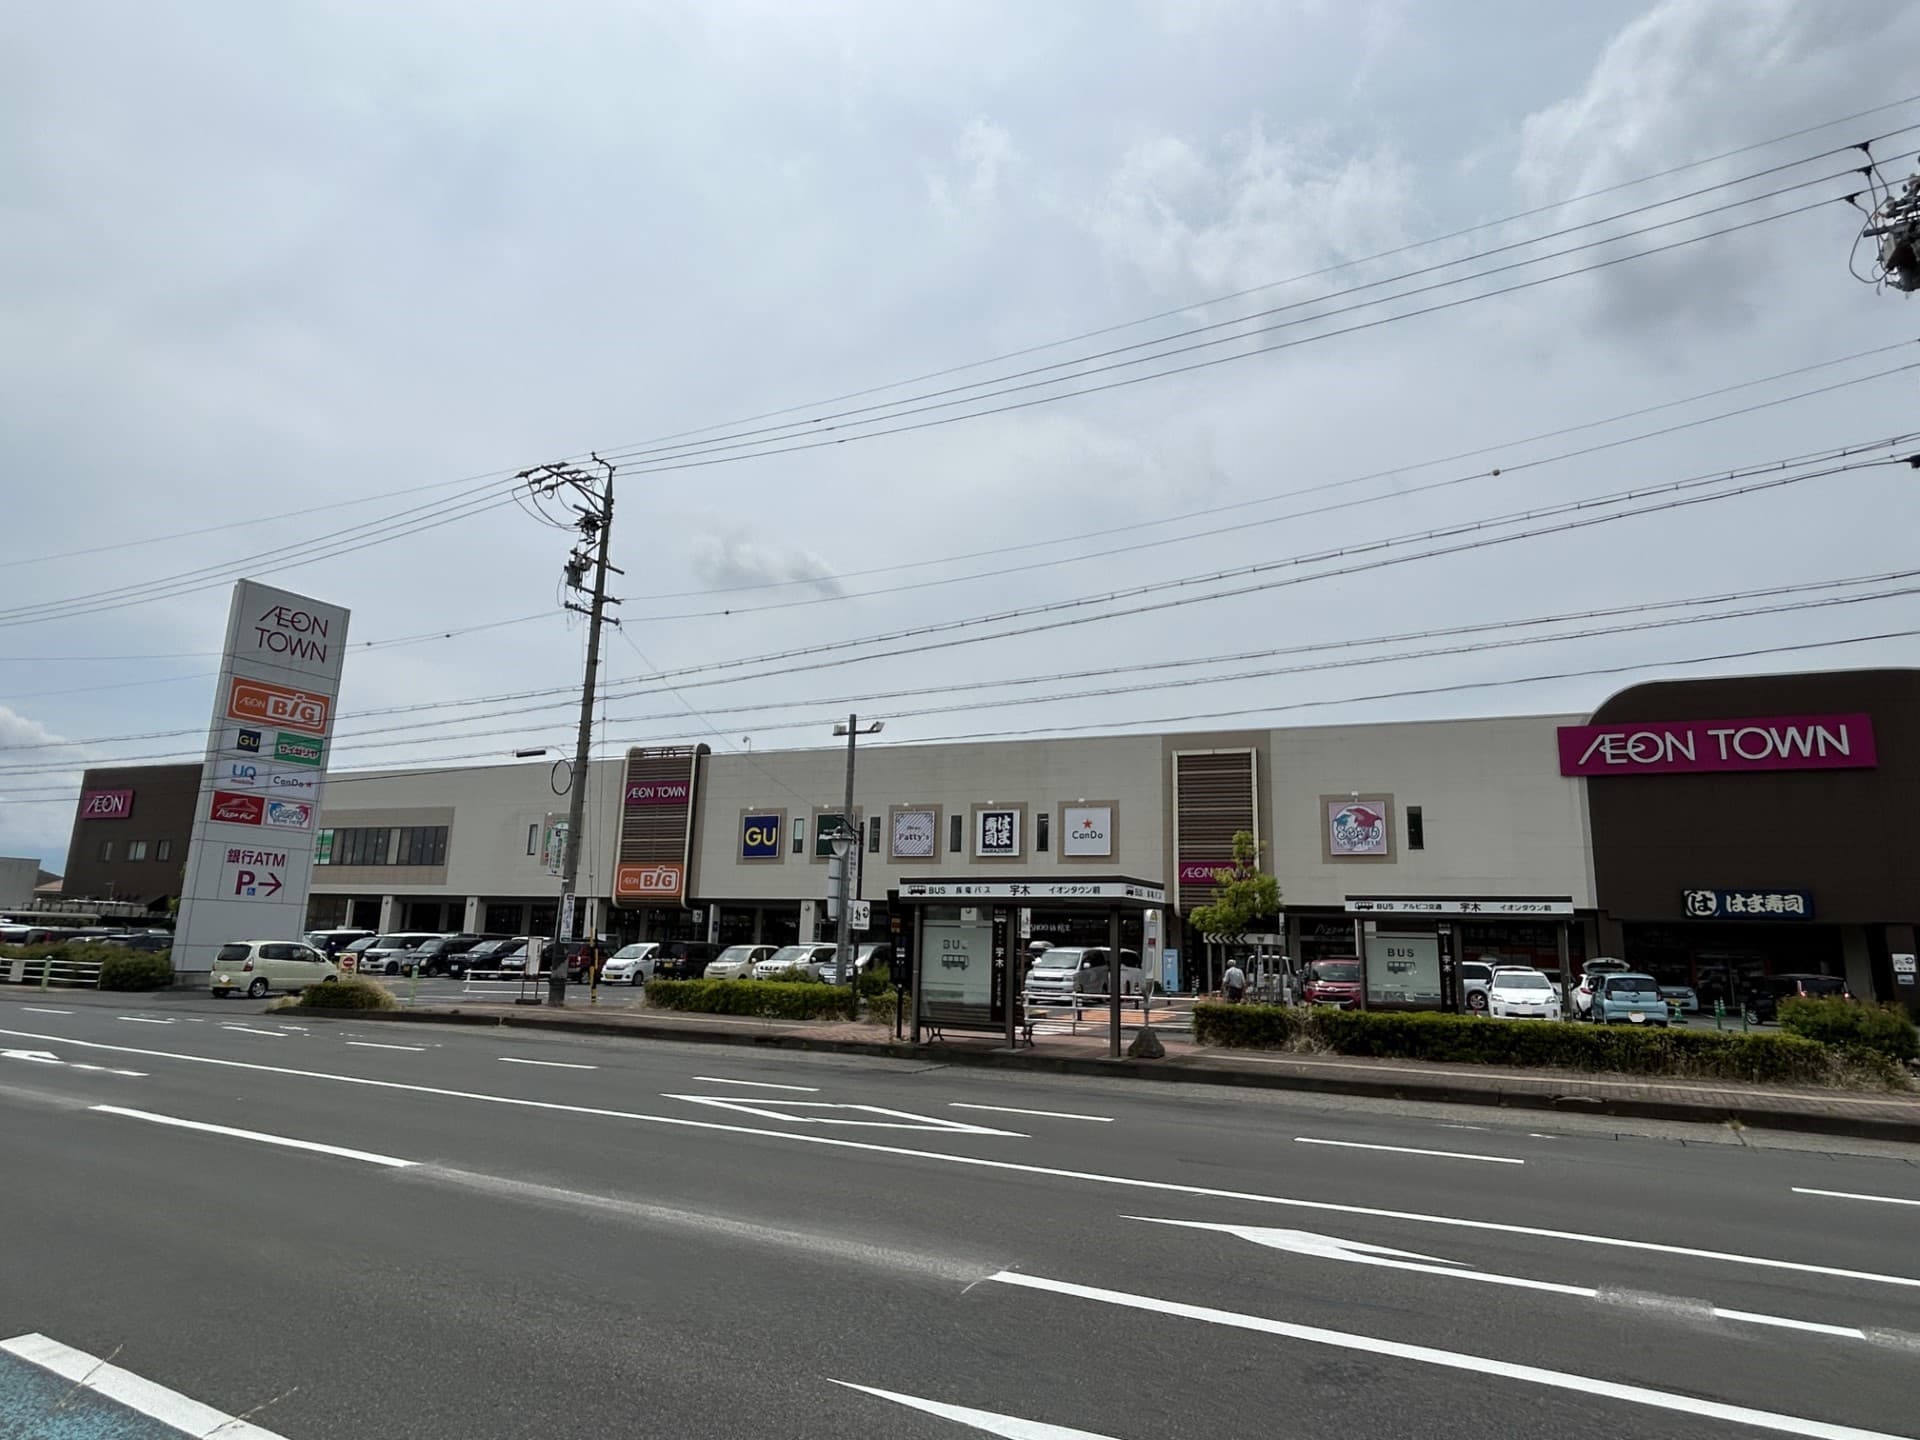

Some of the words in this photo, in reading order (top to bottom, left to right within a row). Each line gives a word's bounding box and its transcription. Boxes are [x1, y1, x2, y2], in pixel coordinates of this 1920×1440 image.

[255, 626, 328, 663] TOWN
[271, 693, 316, 721] BIG
[239, 734, 260, 747] GU
[1707, 724, 1850, 760] TOWN
[232, 764, 256, 780] UQ
[656, 785, 686, 798] TOWN
[745, 826, 777, 846] GU
[1071, 829, 1104, 840] CanDo
[226, 847, 286, 868] 銀行ATM
[234, 869, 256, 895] P
[642, 865, 674, 888] BIG
[927, 886, 946, 895] BUS
[1009, 884, 1031, 896] 宇木
[1459, 902, 1481, 912] 宇木
[1726, 893, 1805, 914] はま寿司
[1387, 948, 1415, 958] BUS
